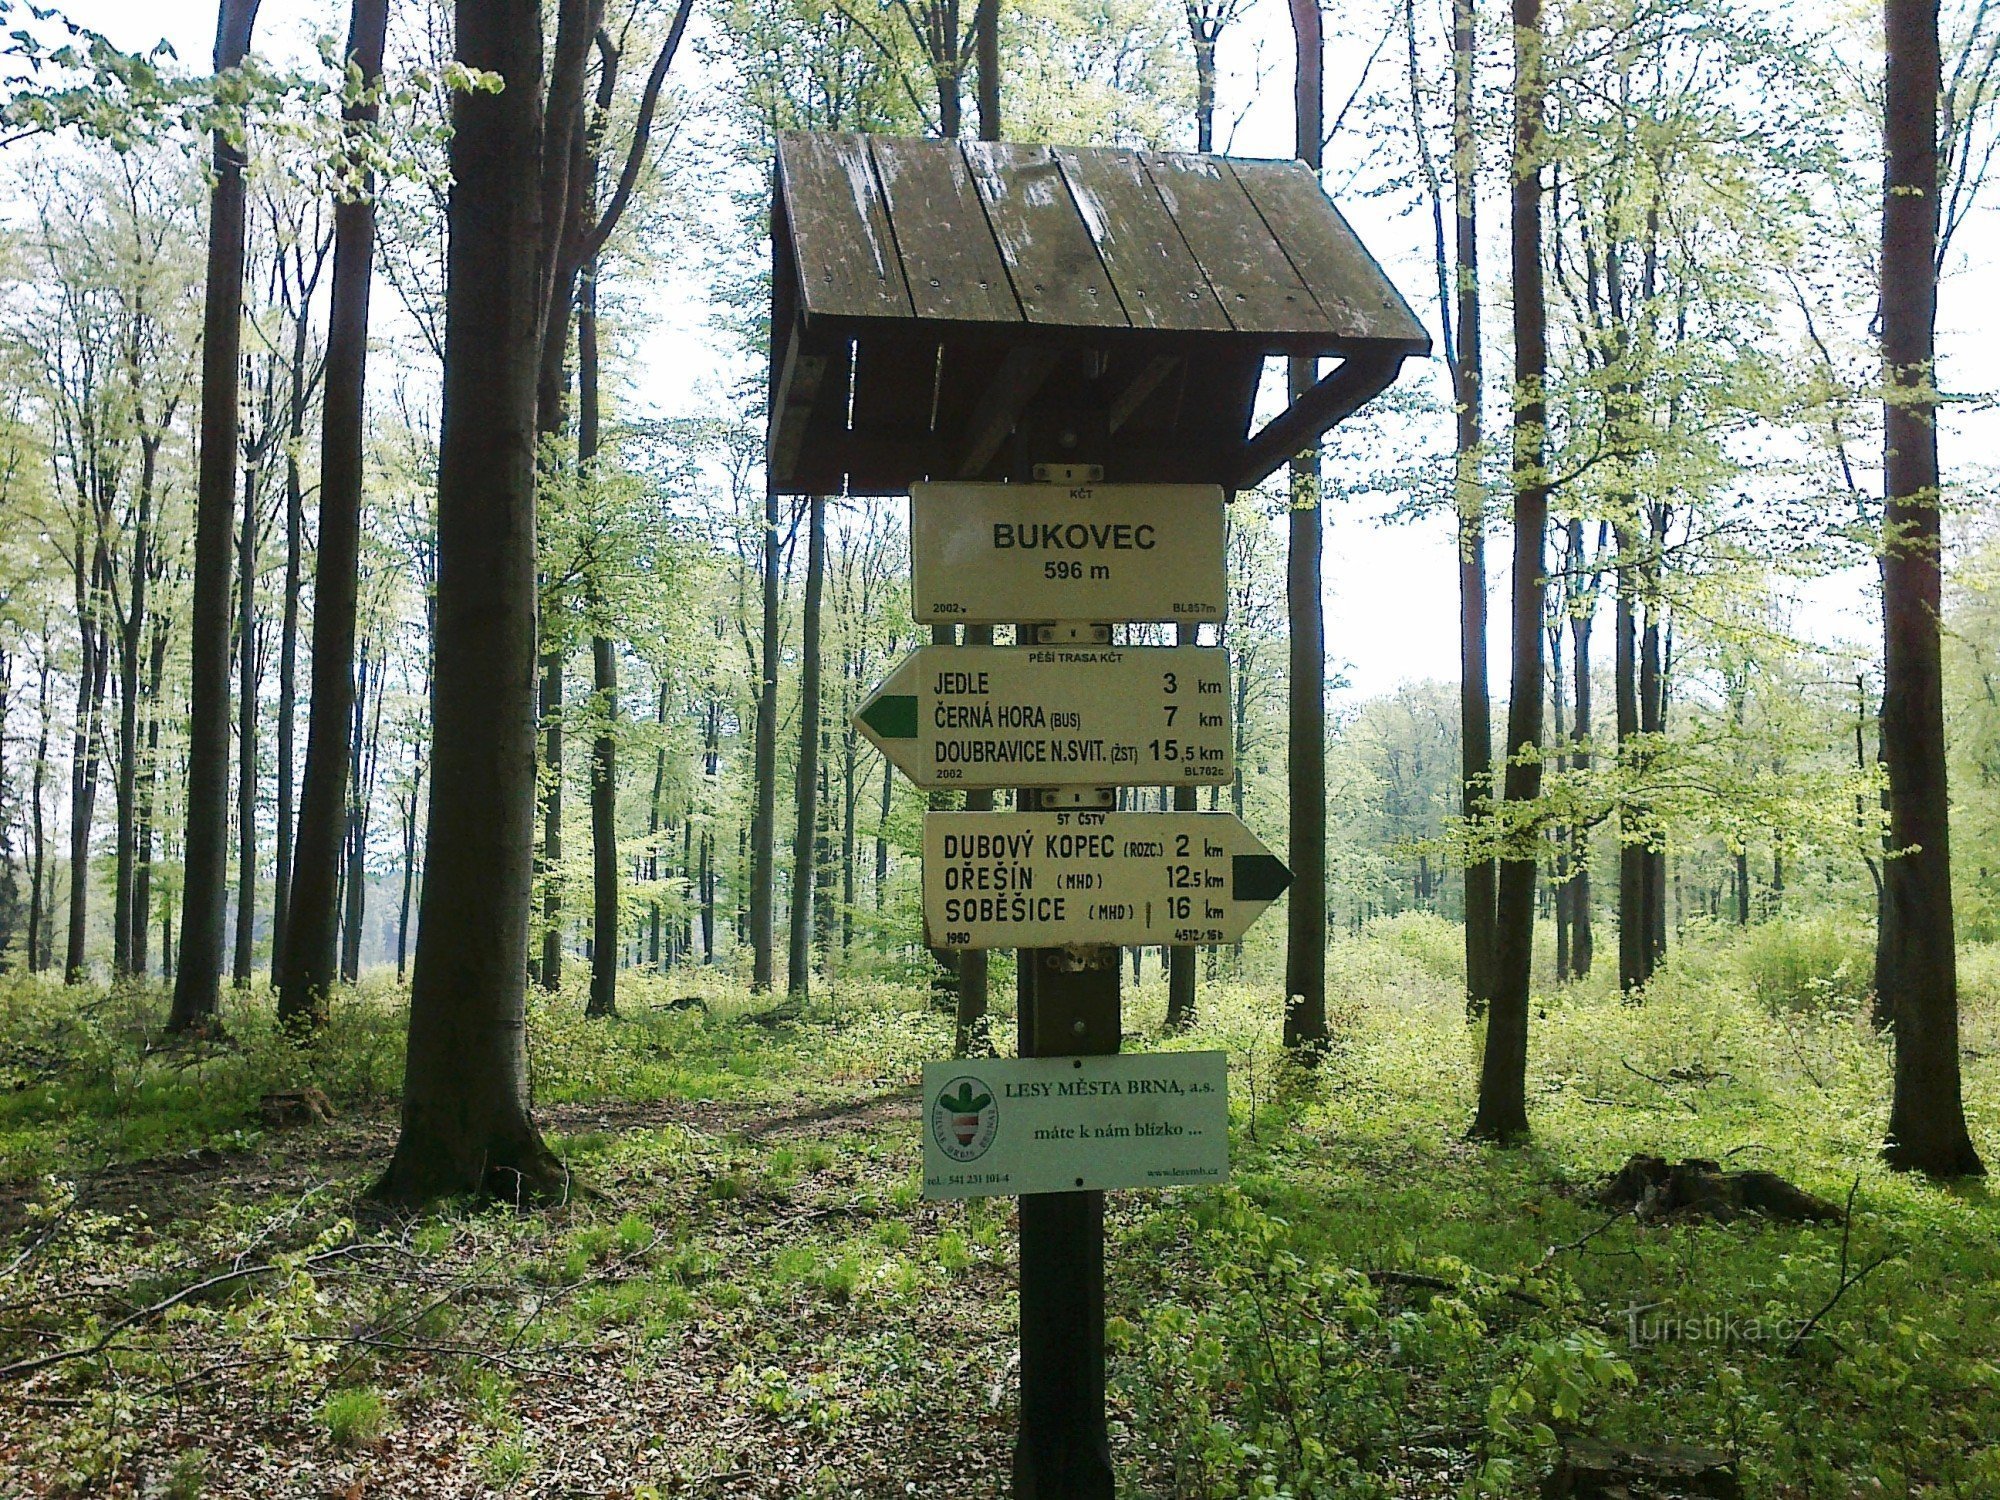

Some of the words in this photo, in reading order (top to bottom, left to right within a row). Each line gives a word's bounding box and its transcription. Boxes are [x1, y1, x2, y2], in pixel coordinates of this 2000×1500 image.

[1070, 488, 1092, 498] KČT
[994, 524, 1155, 549] BUKOVEC
[1045, 561, 1082, 579] 596
[1091, 566, 1109, 579] m
[1029, 651, 1055, 663] PĚŠÍ
[1058, 653, 1097, 662] TRASA
[1101, 652, 1123, 662] KČT
[934, 672, 989, 694] JEDLE
[1164, 673, 1177, 693] 3
[1198, 680, 1221, 693] km
[935, 701, 993, 728] ČERNÁ
[998, 709, 1046, 728] HORA
[1051, 713, 1080, 731] (BUS)
[1164, 706, 1178, 726] 7
[1200, 713, 1222, 726] km
[936, 740, 1046, 762] DOUBRAVICE
[1052, 740, 1106, 761] N.SVIT.
[1200, 746, 1223, 760] km
[936, 769, 962, 778] 2002
[1057, 813, 1070, 825] ST
[945, 829, 1034, 858] DUBOVÝ
[1046, 835, 1114, 858] KOPEC
[1176, 835, 1189, 857] 2
[1205, 838, 1223, 857] km
[946, 861, 1032, 890] OŘEŠÍN
[1205, 869, 1223, 887] km
[946, 893, 1065, 922] SOBĚŠICE
[1167, 897, 1190, 919] 16
[1206, 900, 1223, 918] km
[1006, 1083, 1052, 1097] LESY
[1058, 1078, 1121, 1095] MĚSTA
[1128, 1080, 1184, 1096] BRNA,
[1190, 1083, 1214, 1092] a.s.
[1035, 1126, 1074, 1139] máte
[1080, 1125, 1090, 1138] k
[1095, 1124, 1130, 1137] nám
[1135, 1122, 1183, 1136] blízko
